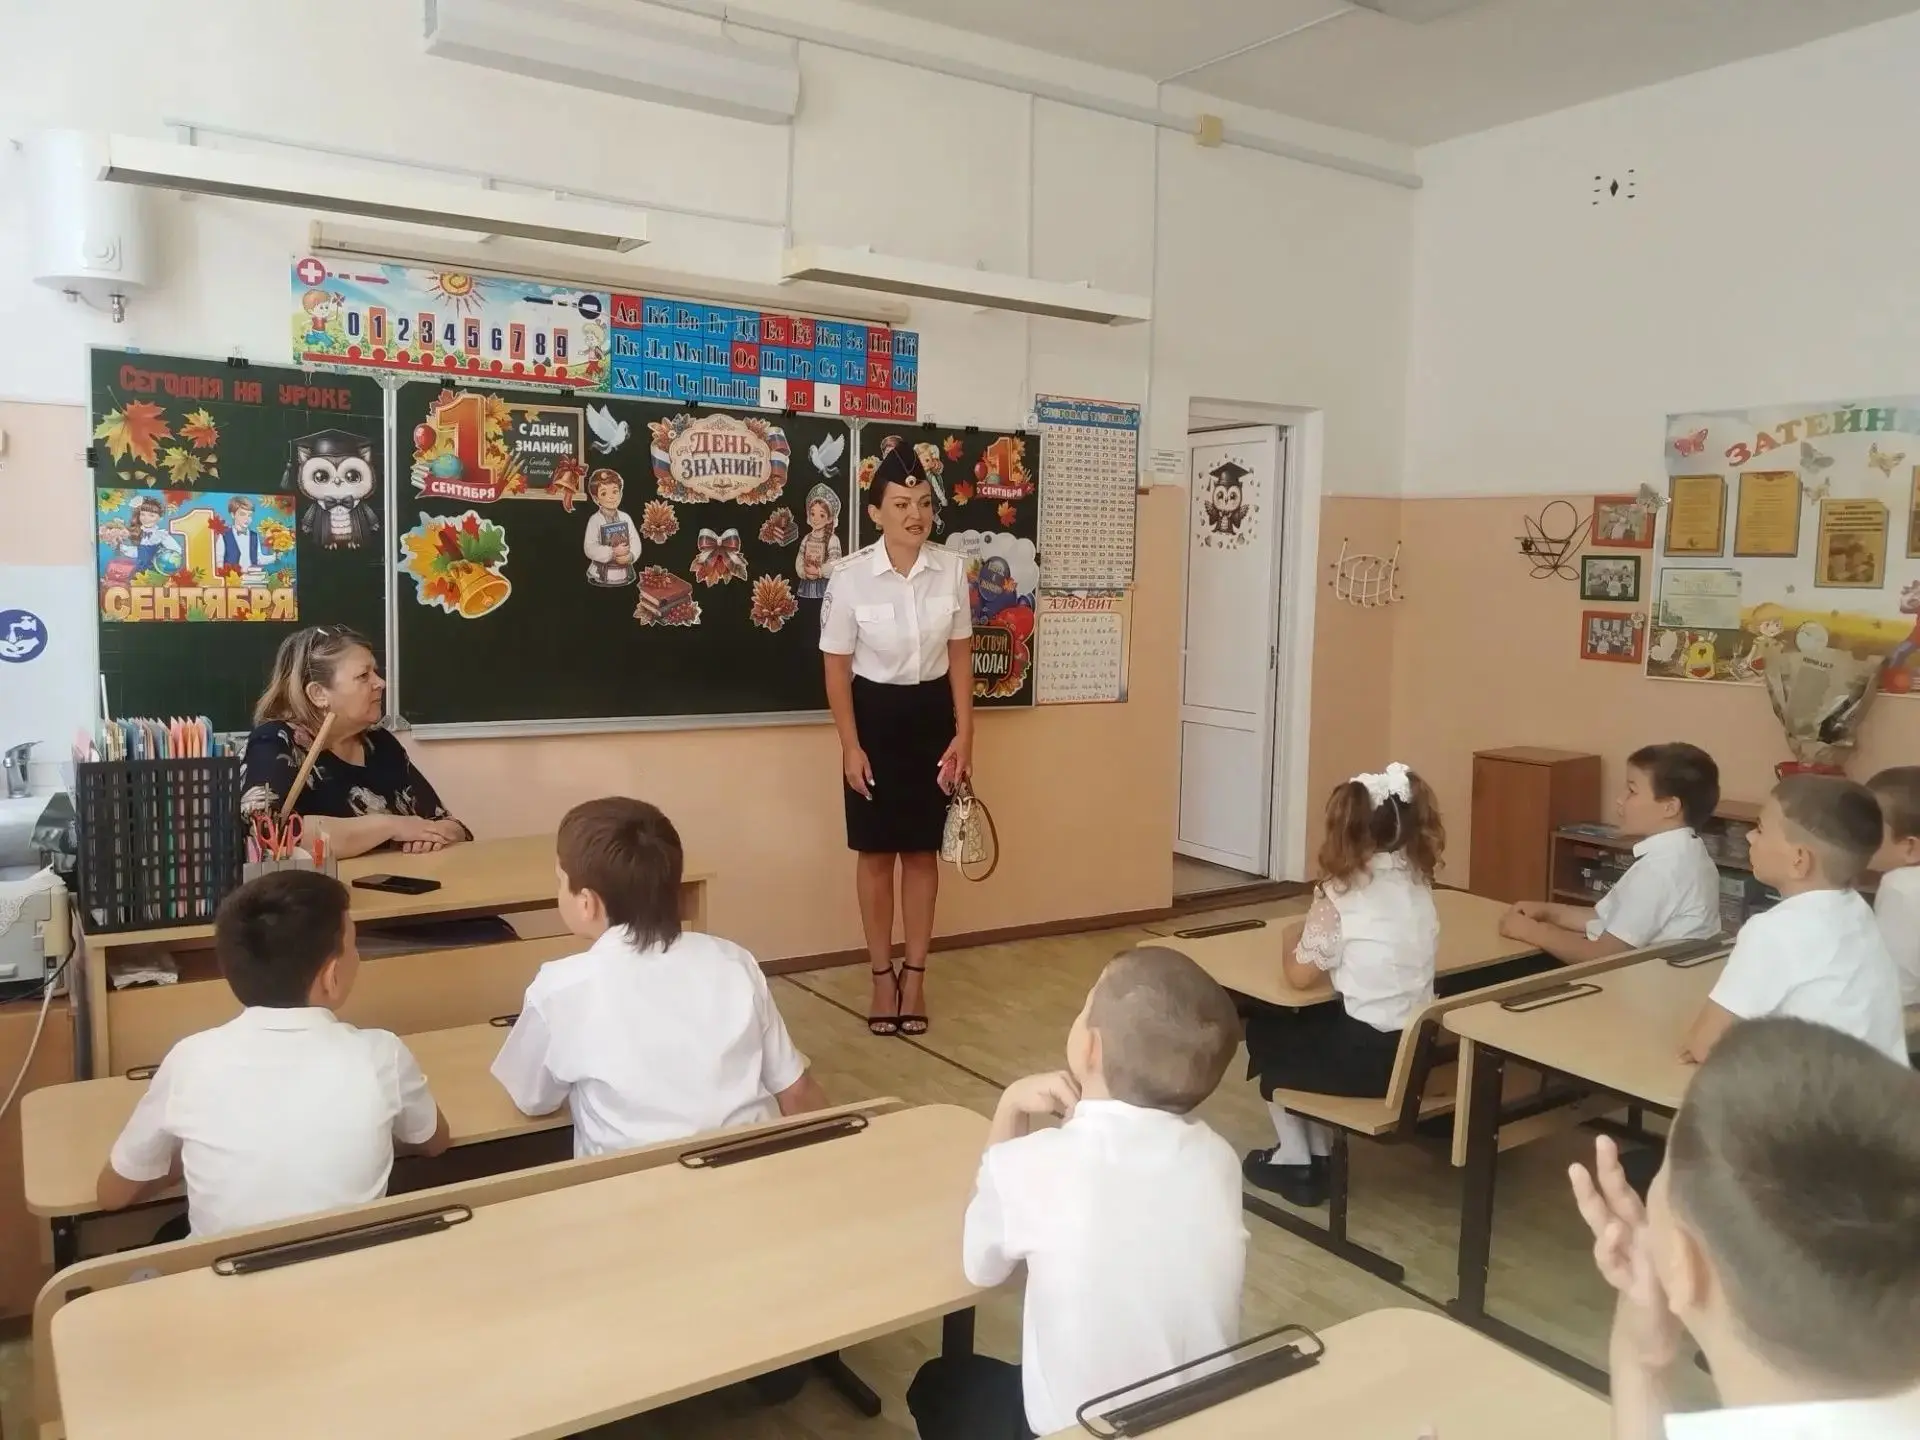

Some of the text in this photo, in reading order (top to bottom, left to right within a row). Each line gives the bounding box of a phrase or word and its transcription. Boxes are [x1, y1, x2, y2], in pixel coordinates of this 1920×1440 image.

[347, 312, 567, 357] 0 1 2 3 4 5 6 7 8 9
[616, 301, 639, 323] Аа
[647, 305, 670, 328] Бб
[677, 308, 700, 331] Вв
[733, 315, 758, 341] Дд
[763, 319, 784, 341] Ее
[815, 326, 841, 348] Жж
[846, 330, 864, 351] Зз
[869, 333, 891, 354] Ии
[894, 333, 917, 357] Йй
[614, 334, 918, 392] Кк Лл Мм Нн Оо Пп Рр Сс Тт Уу Фф
[234, 380, 262, 403] НА
[279, 384, 351, 410] УРОКЕ
[614, 367, 639, 390] Хх
[644, 370, 672, 397] Цц
[676, 373, 700, 396] Чч
[703, 376, 731, 397] Шш
[732, 379, 759, 404] Щщ
[844, 390, 863, 411] Ээ
[866, 392, 891, 414] Юю
[894, 395, 915, 417] Яя
[437, 393, 494, 484] 1
[519, 422, 569, 437] С ДНЁМ
[515, 440, 573, 454] ЗНАНИЙ!
[690, 432, 750, 454] ДЕНЬ
[681, 457, 763, 480] ЗНАНИЙ!
[987, 437, 1016, 486] 1
[431, 481, 496, 499] СЕНТЯБРЯ
[982, 486, 1022, 498] СЕНТЯБРЯ
[169, 509, 225, 587] 1
[104, 586, 296, 620] СЕНТЯБРЯ
[1049, 599, 1114, 610] АЛФАВИТ
[970, 634, 1010, 654] АВСТВУЙ,
[972, 652, 1008, 674] КОЛА!
